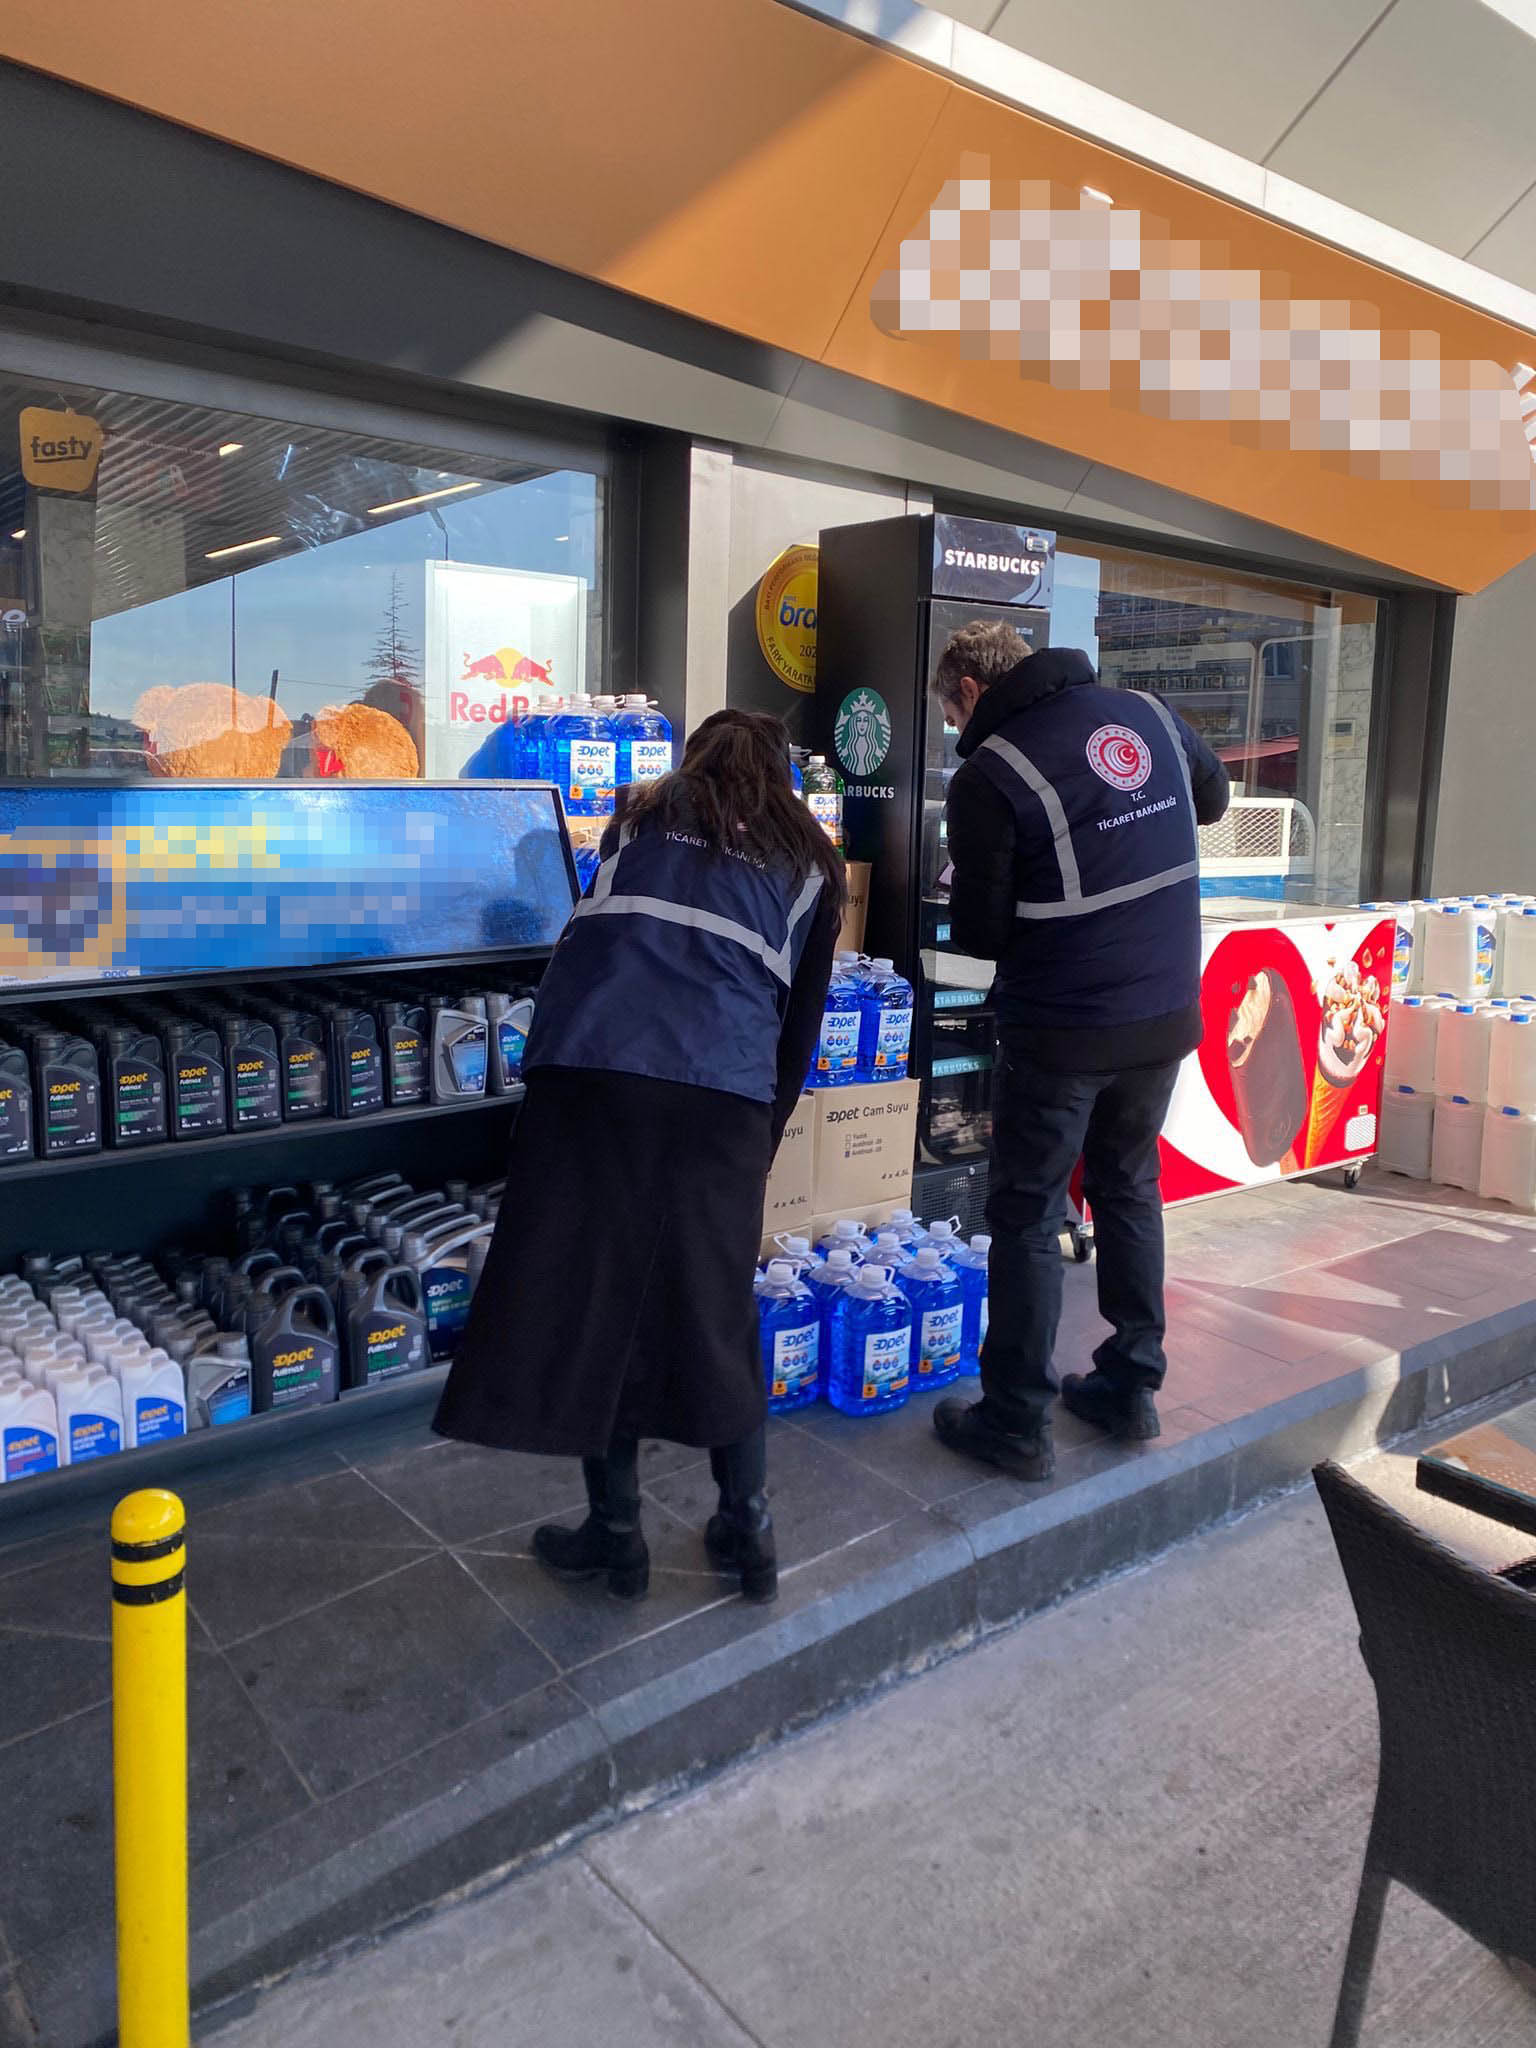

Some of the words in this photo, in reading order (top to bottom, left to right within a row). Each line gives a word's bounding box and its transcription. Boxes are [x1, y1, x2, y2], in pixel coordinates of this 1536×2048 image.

[30, 435, 92, 461] fasty
[945, 549, 1041, 576] STARBUCKS
[450, 691, 507, 724] Red
[1096, 811, 1136, 831] TİCARET
[826, 1107, 860, 1123] opet
[863, 1106, 885, 1117] Cam
[886, 1103, 909, 1115] Suyu
[784, 1126, 804, 1138] uyu
[368, 1323, 407, 1344] opet
[273, 1346, 315, 1368] opet
